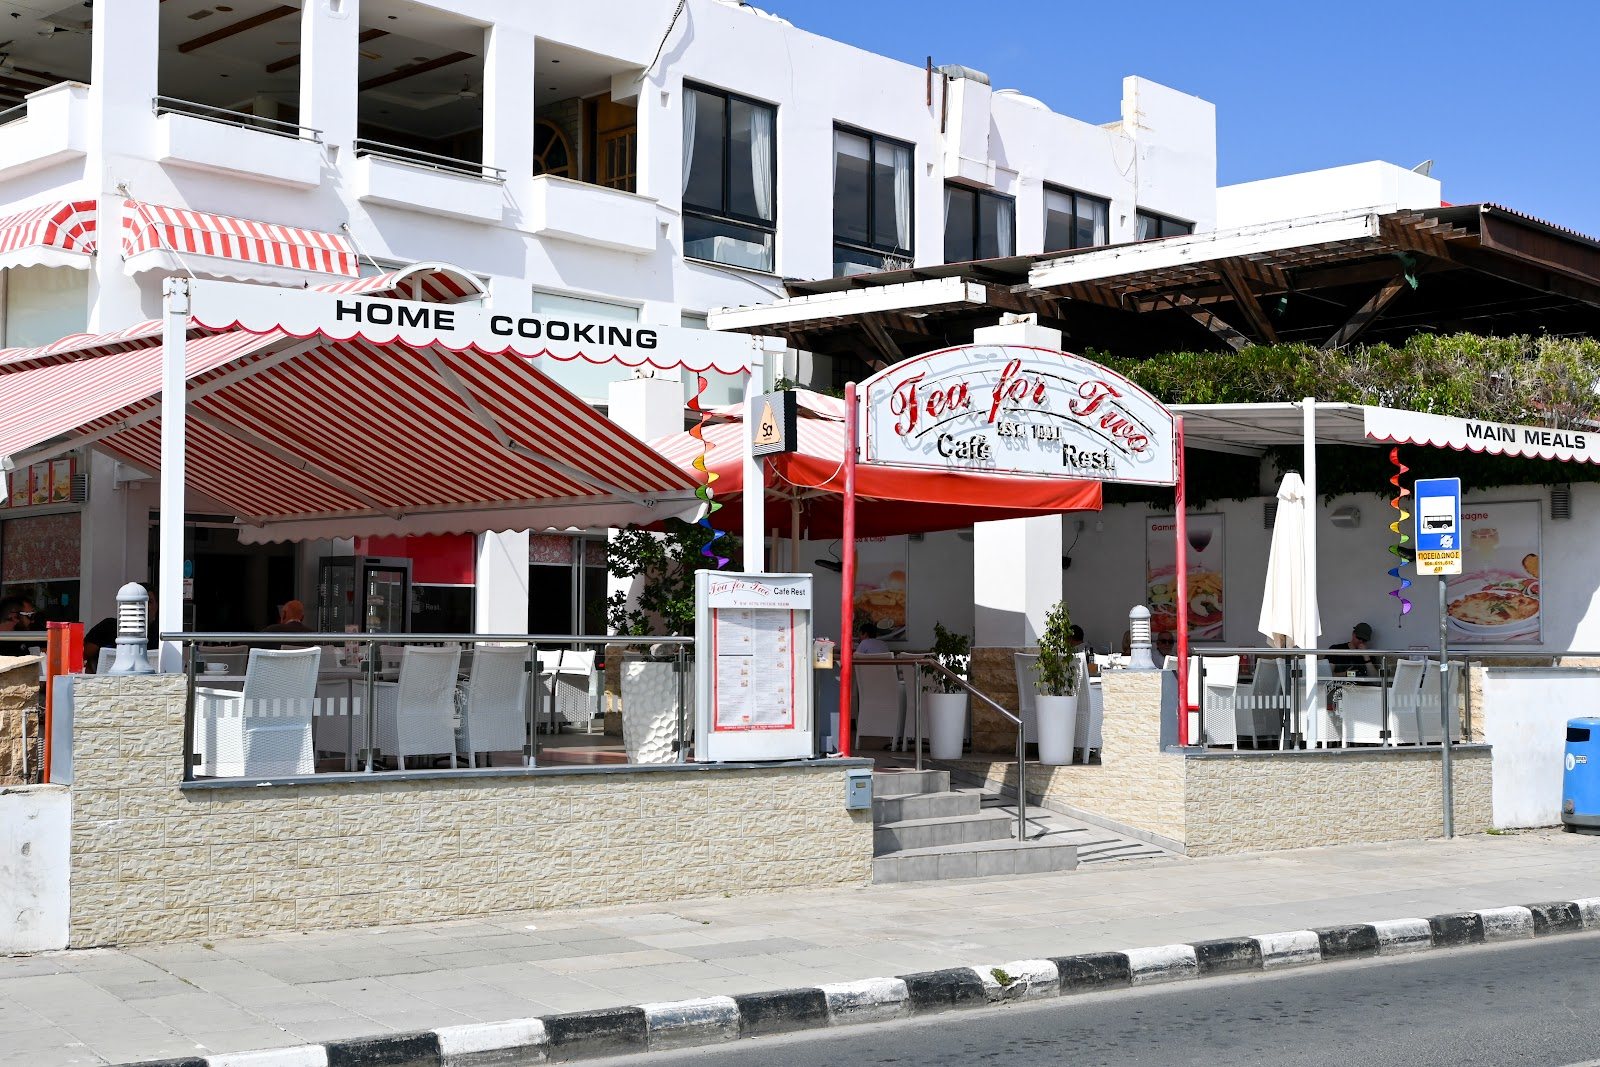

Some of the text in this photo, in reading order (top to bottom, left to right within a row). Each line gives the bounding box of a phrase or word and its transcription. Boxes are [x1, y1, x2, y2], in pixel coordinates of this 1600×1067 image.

[336, 299, 657, 350] HOME COOKING
[890, 357, 1149, 453] Tea for Two
[937, 432, 992, 461] Café
[1465, 423, 1586, 450] MAIN MEALS
[709, 582, 728, 595] Tea
[731, 579, 745, 593] for
[749, 581, 770, 596] Two
[773, 587, 790, 596] Café
